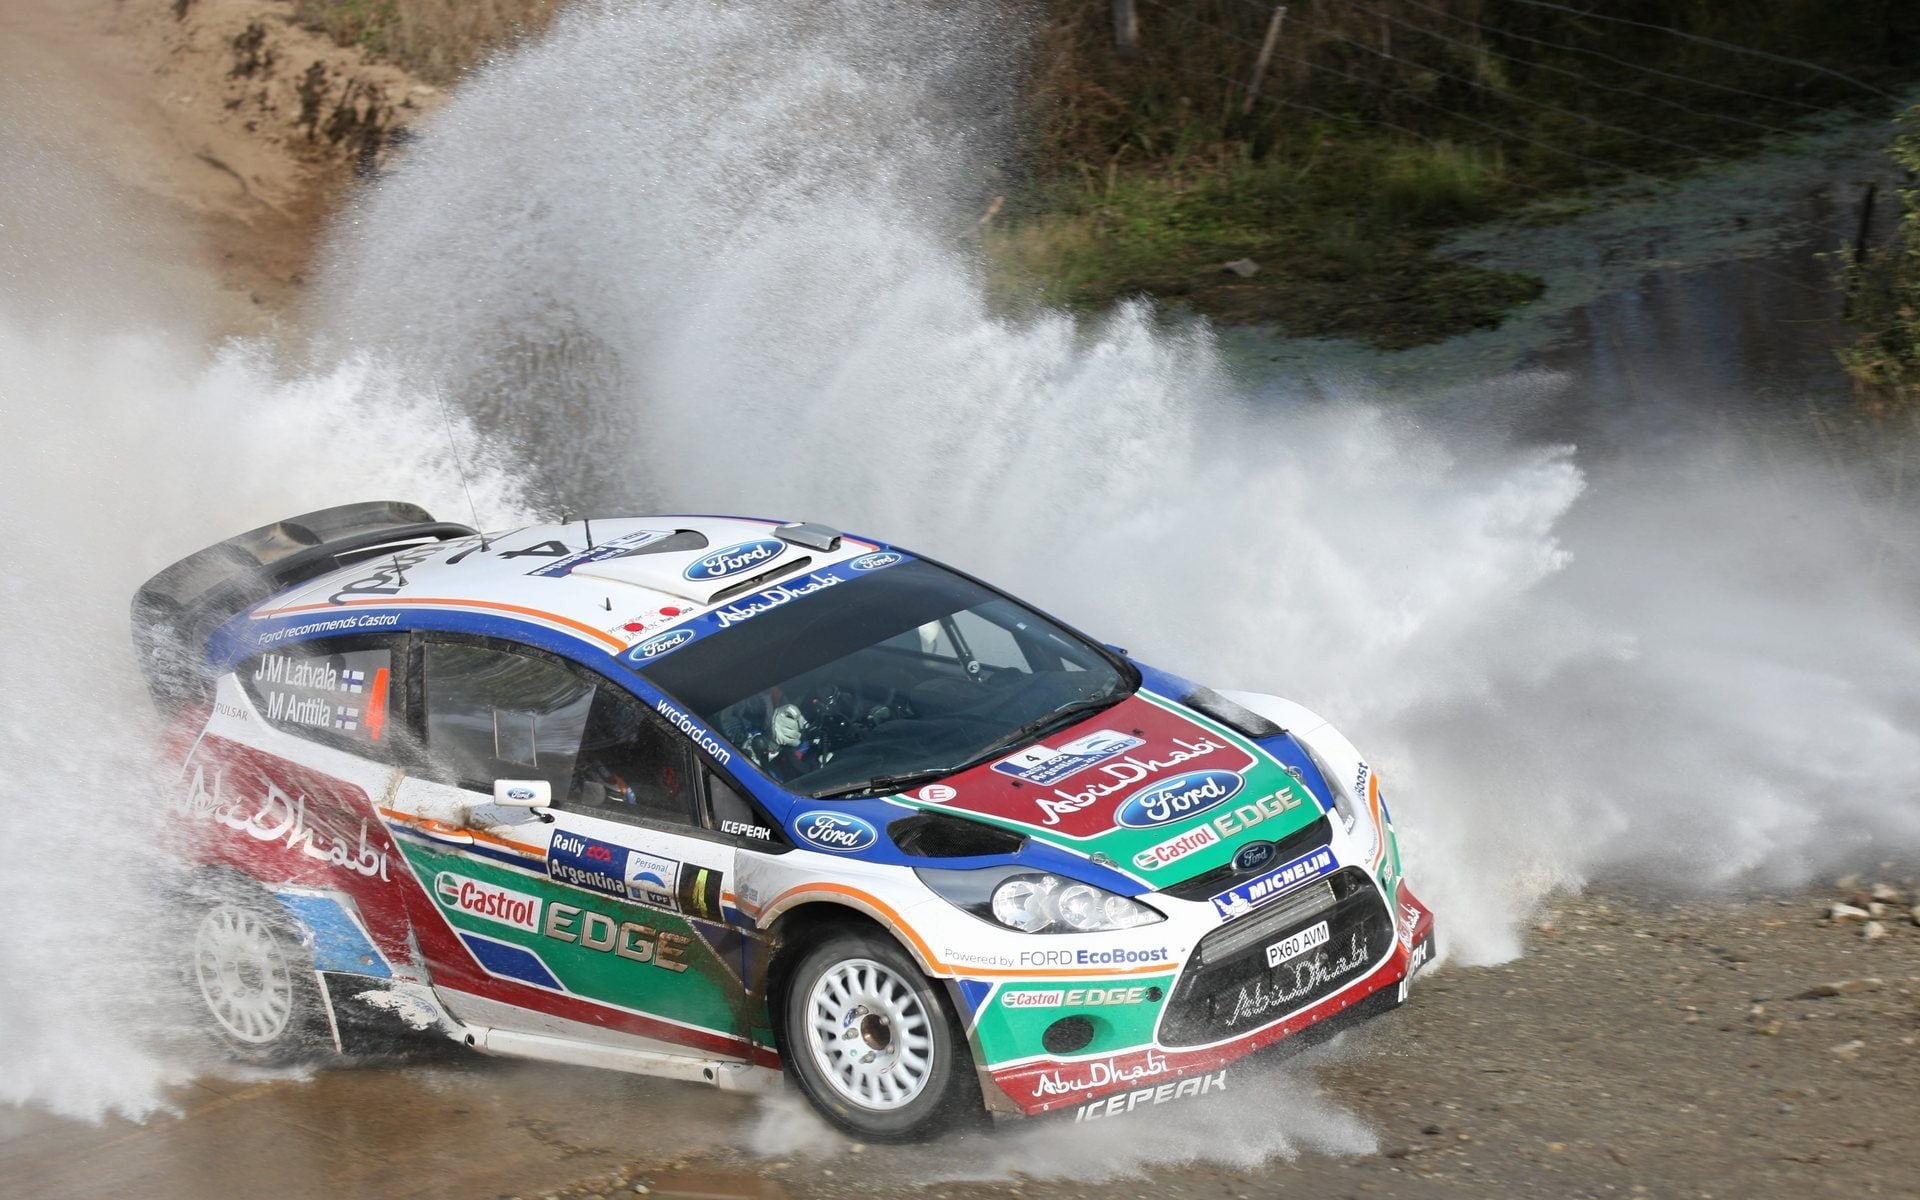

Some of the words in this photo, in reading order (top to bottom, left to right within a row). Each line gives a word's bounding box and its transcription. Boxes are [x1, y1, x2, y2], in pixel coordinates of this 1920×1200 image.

[703, 544, 771, 576] Ford
[862, 554, 895, 569] Ford
[258, 628, 285, 645] Ford
[284, 616, 355, 637] recommends
[358, 613, 400, 628] Castrol
[643, 635, 685, 657] Ford
[255, 653, 267, 681] J
[267, 654, 283, 683] M
[285, 657, 337, 691] Latvala
[215, 703, 248, 721] PULSAR
[267, 691, 285, 720] M
[284, 694, 331, 727] Anttila
[656, 700, 731, 765] wrcford.com
[1142, 775, 1226, 821] Ford
[720, 820, 771, 841] ICEPEAK
[807, 815, 862, 847] Ford
[1155, 828, 1214, 864] Castrol
[1213, 786, 1302, 838] EDGE
[552, 834, 585, 857] Rally
[1243, 847, 1268, 866] Ford
[551, 859, 626, 894] Argentina
[635, 857, 669, 873] Personal
[1249, 849, 1330, 898] MICHELIN
[460, 881, 535, 928] Castrol
[544, 901, 694, 973] EDGE
[1269, 937, 1300, 960] PX60
[1303, 924, 1328, 948] AVM
[945, 949, 997, 966] Powered
[999, 954, 1015, 967] by
[1020, 950, 1073, 967] FORD
[1076, 946, 1169, 965] EcoBoost
[1016, 991, 1060, 1006] Castrol
[1063, 986, 1147, 1007] EDGE
[1074, 1069, 1227, 1124] ICEPEAK
